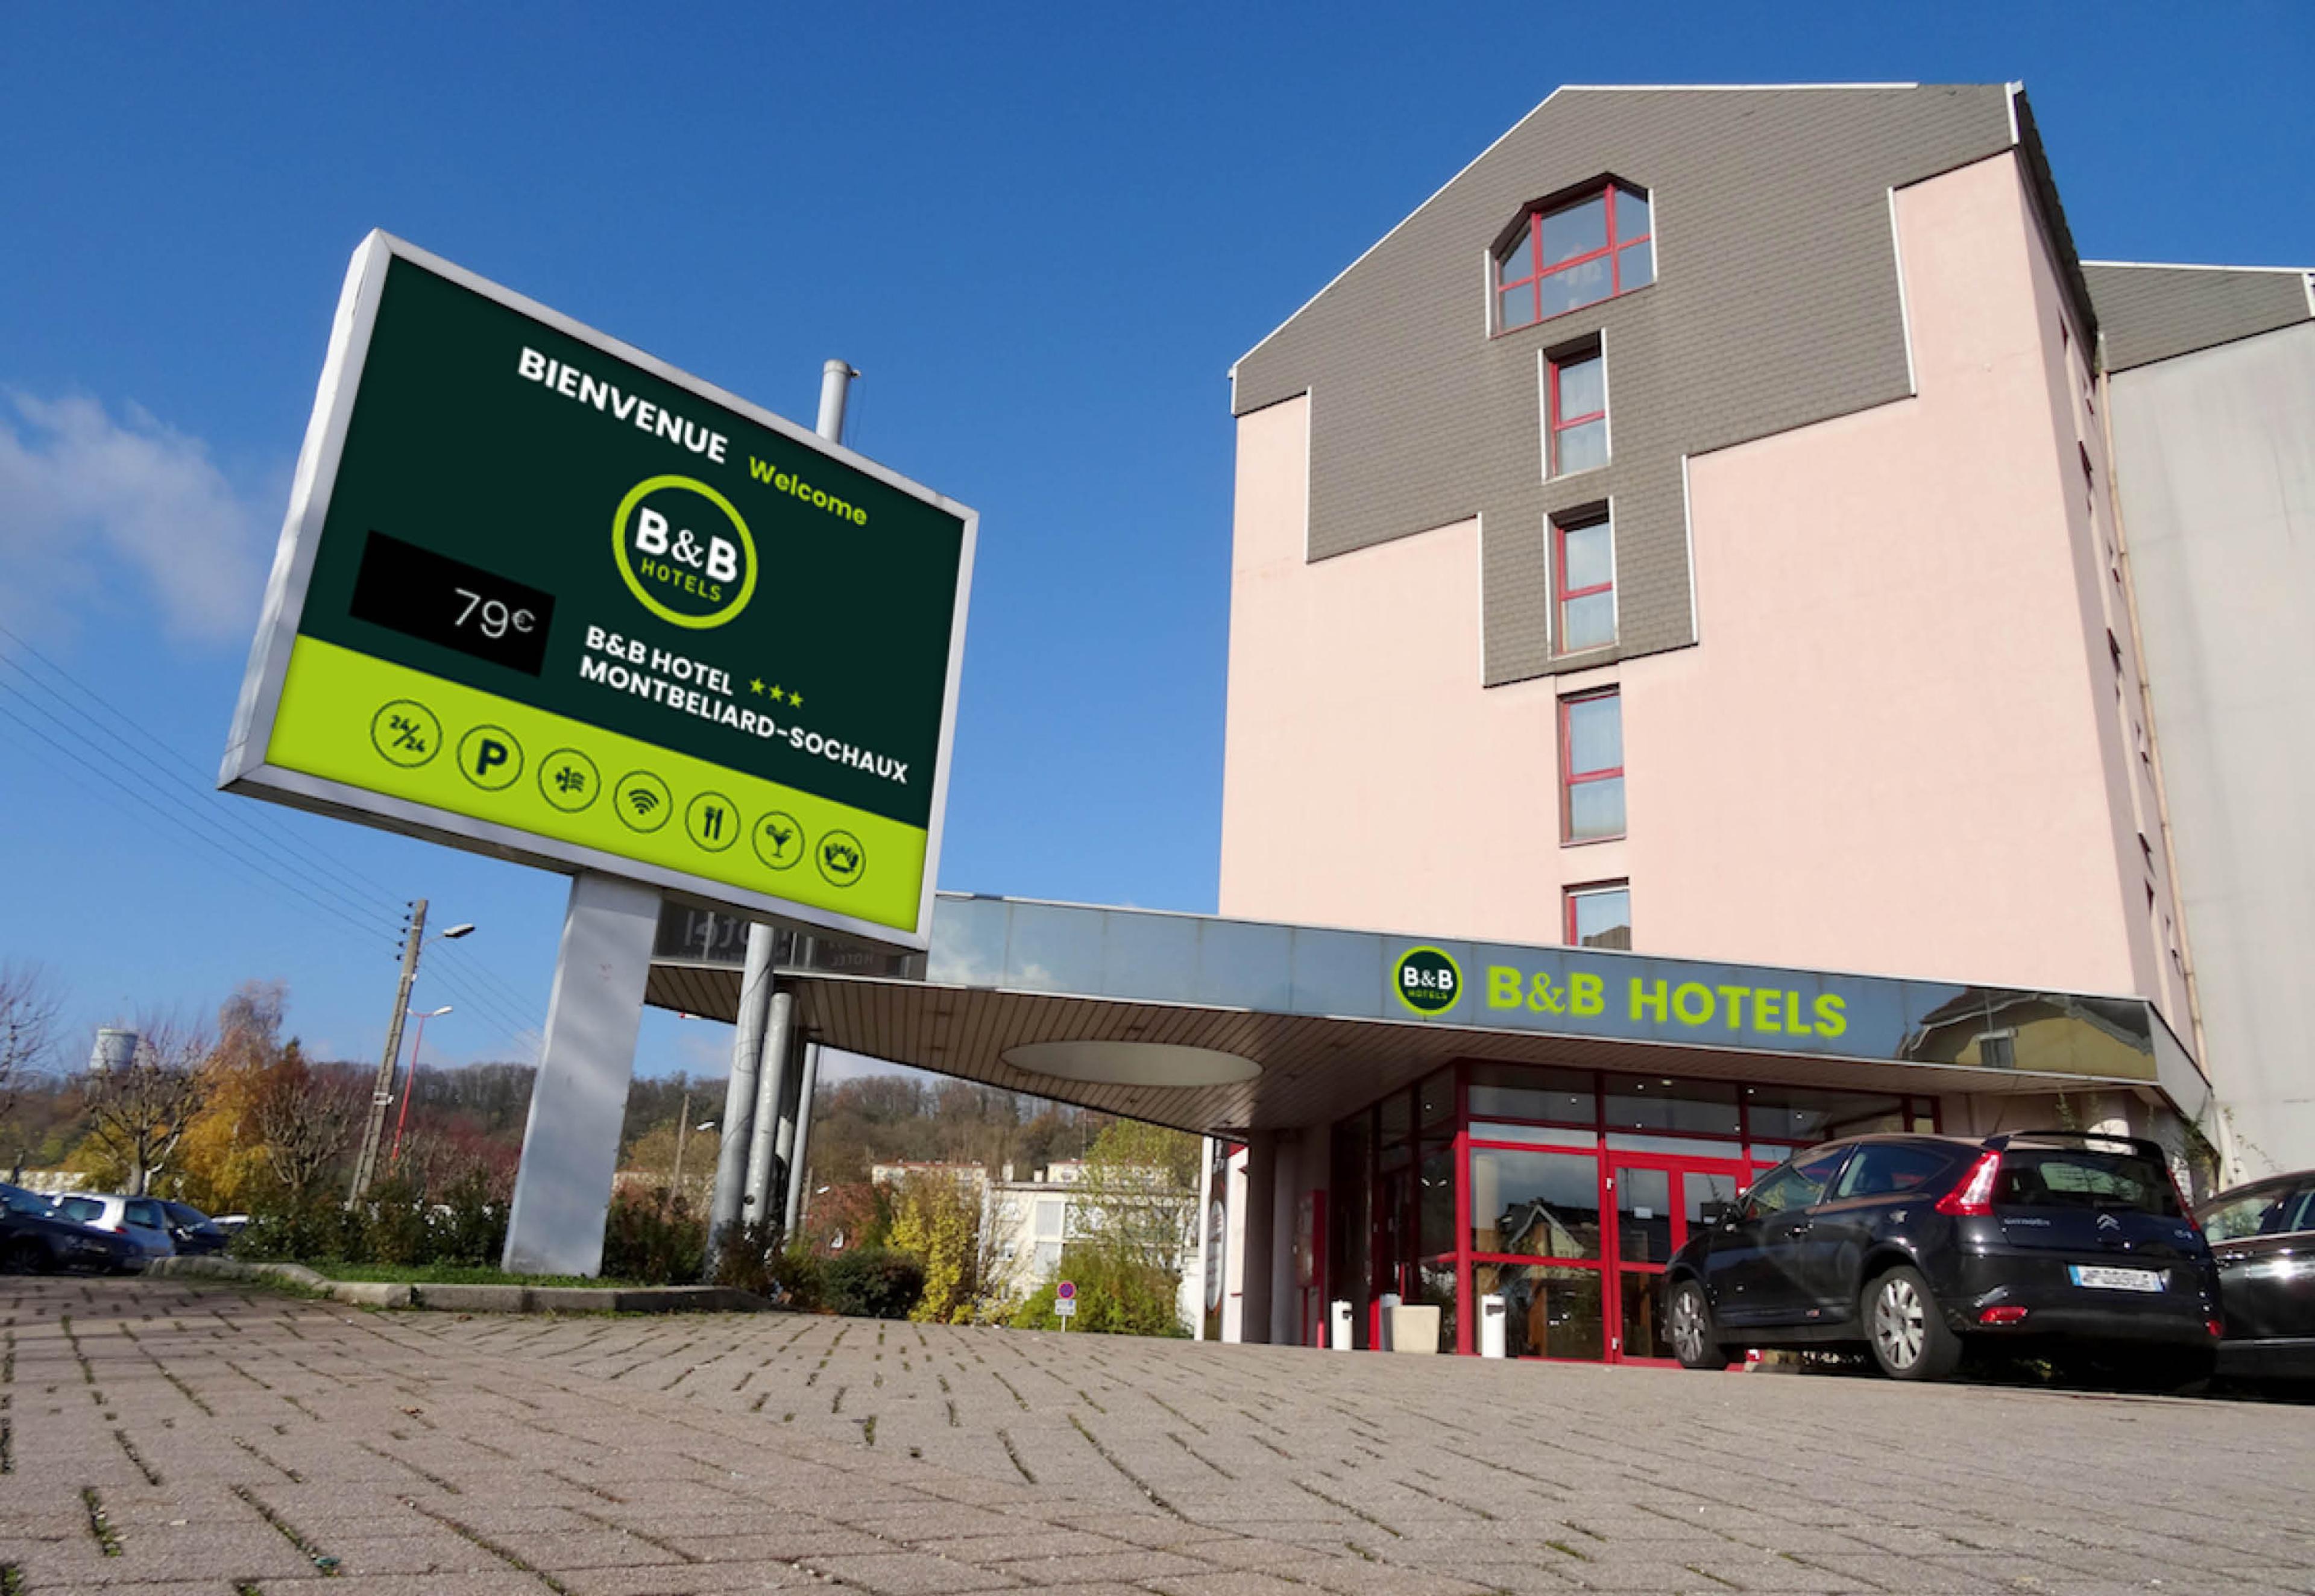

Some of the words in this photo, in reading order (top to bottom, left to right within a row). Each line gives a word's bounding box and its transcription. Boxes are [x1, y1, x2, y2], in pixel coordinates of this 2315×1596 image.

[518, 347, 728, 463] BIENVENUE
[749, 456, 868, 526] Welcome
[635, 508, 738, 582] B&B
[640, 557, 722, 603] HOTELS
[454, 587, 536, 639] 79€
[584, 626, 647, 664] B&B
[650, 648, 733, 697] HOTEL
[579, 656, 909, 785] MONTBELIARD-SOCHAUX
[476, 737, 508, 776] P
[1403, 966, 1454, 990] B&B
[1485, 964, 1605, 1018] B&B
[1628, 976, 1848, 1038] HOTELS
